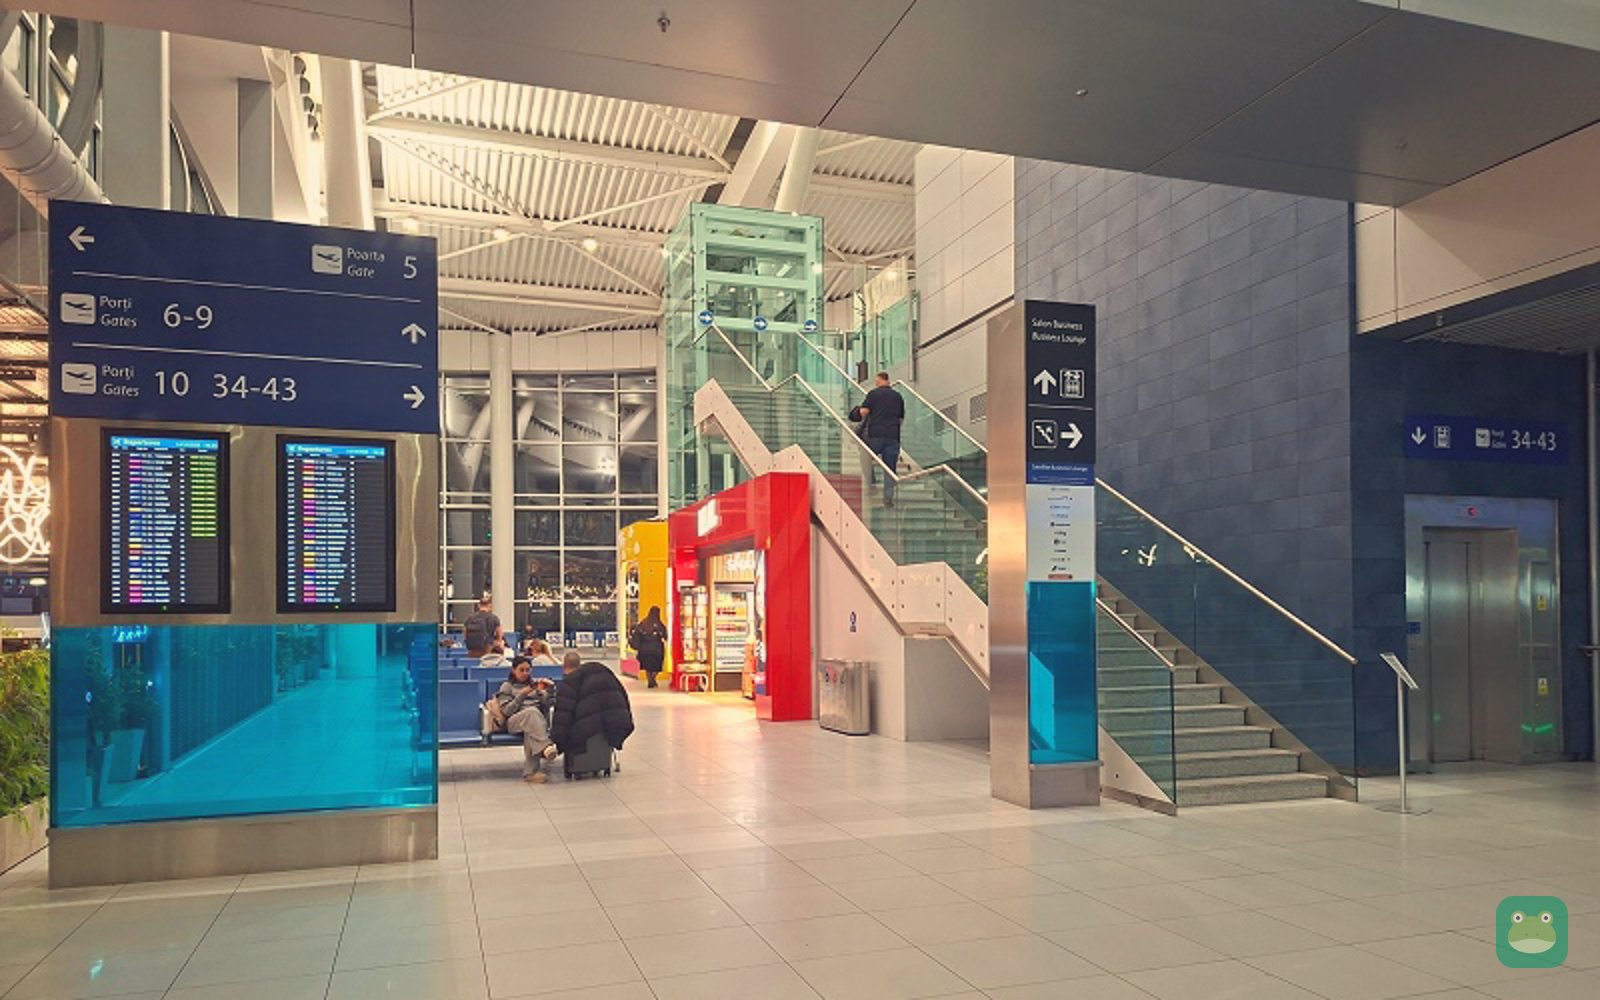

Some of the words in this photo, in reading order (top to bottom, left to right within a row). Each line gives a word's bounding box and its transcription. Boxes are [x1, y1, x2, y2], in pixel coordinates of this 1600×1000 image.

[347, 247, 385, 263] Poarta
[347, 264, 375, 278] Gate
[403, 255, 417, 280] 5
[100, 313, 137, 329] Gates
[163, 303, 214, 330] 6-9
[1031, 317, 1053, 328] Salon
[1053, 319, 1083, 331] Business
[1031, 331, 1061, 342] Business
[1061, 333, 1087, 346] Lounge
[102, 381, 140, 398] Gates
[155, 370, 190, 396] 10
[213, 373, 298, 402] 34-43
[1511, 429, 1557, 451] 34-43
